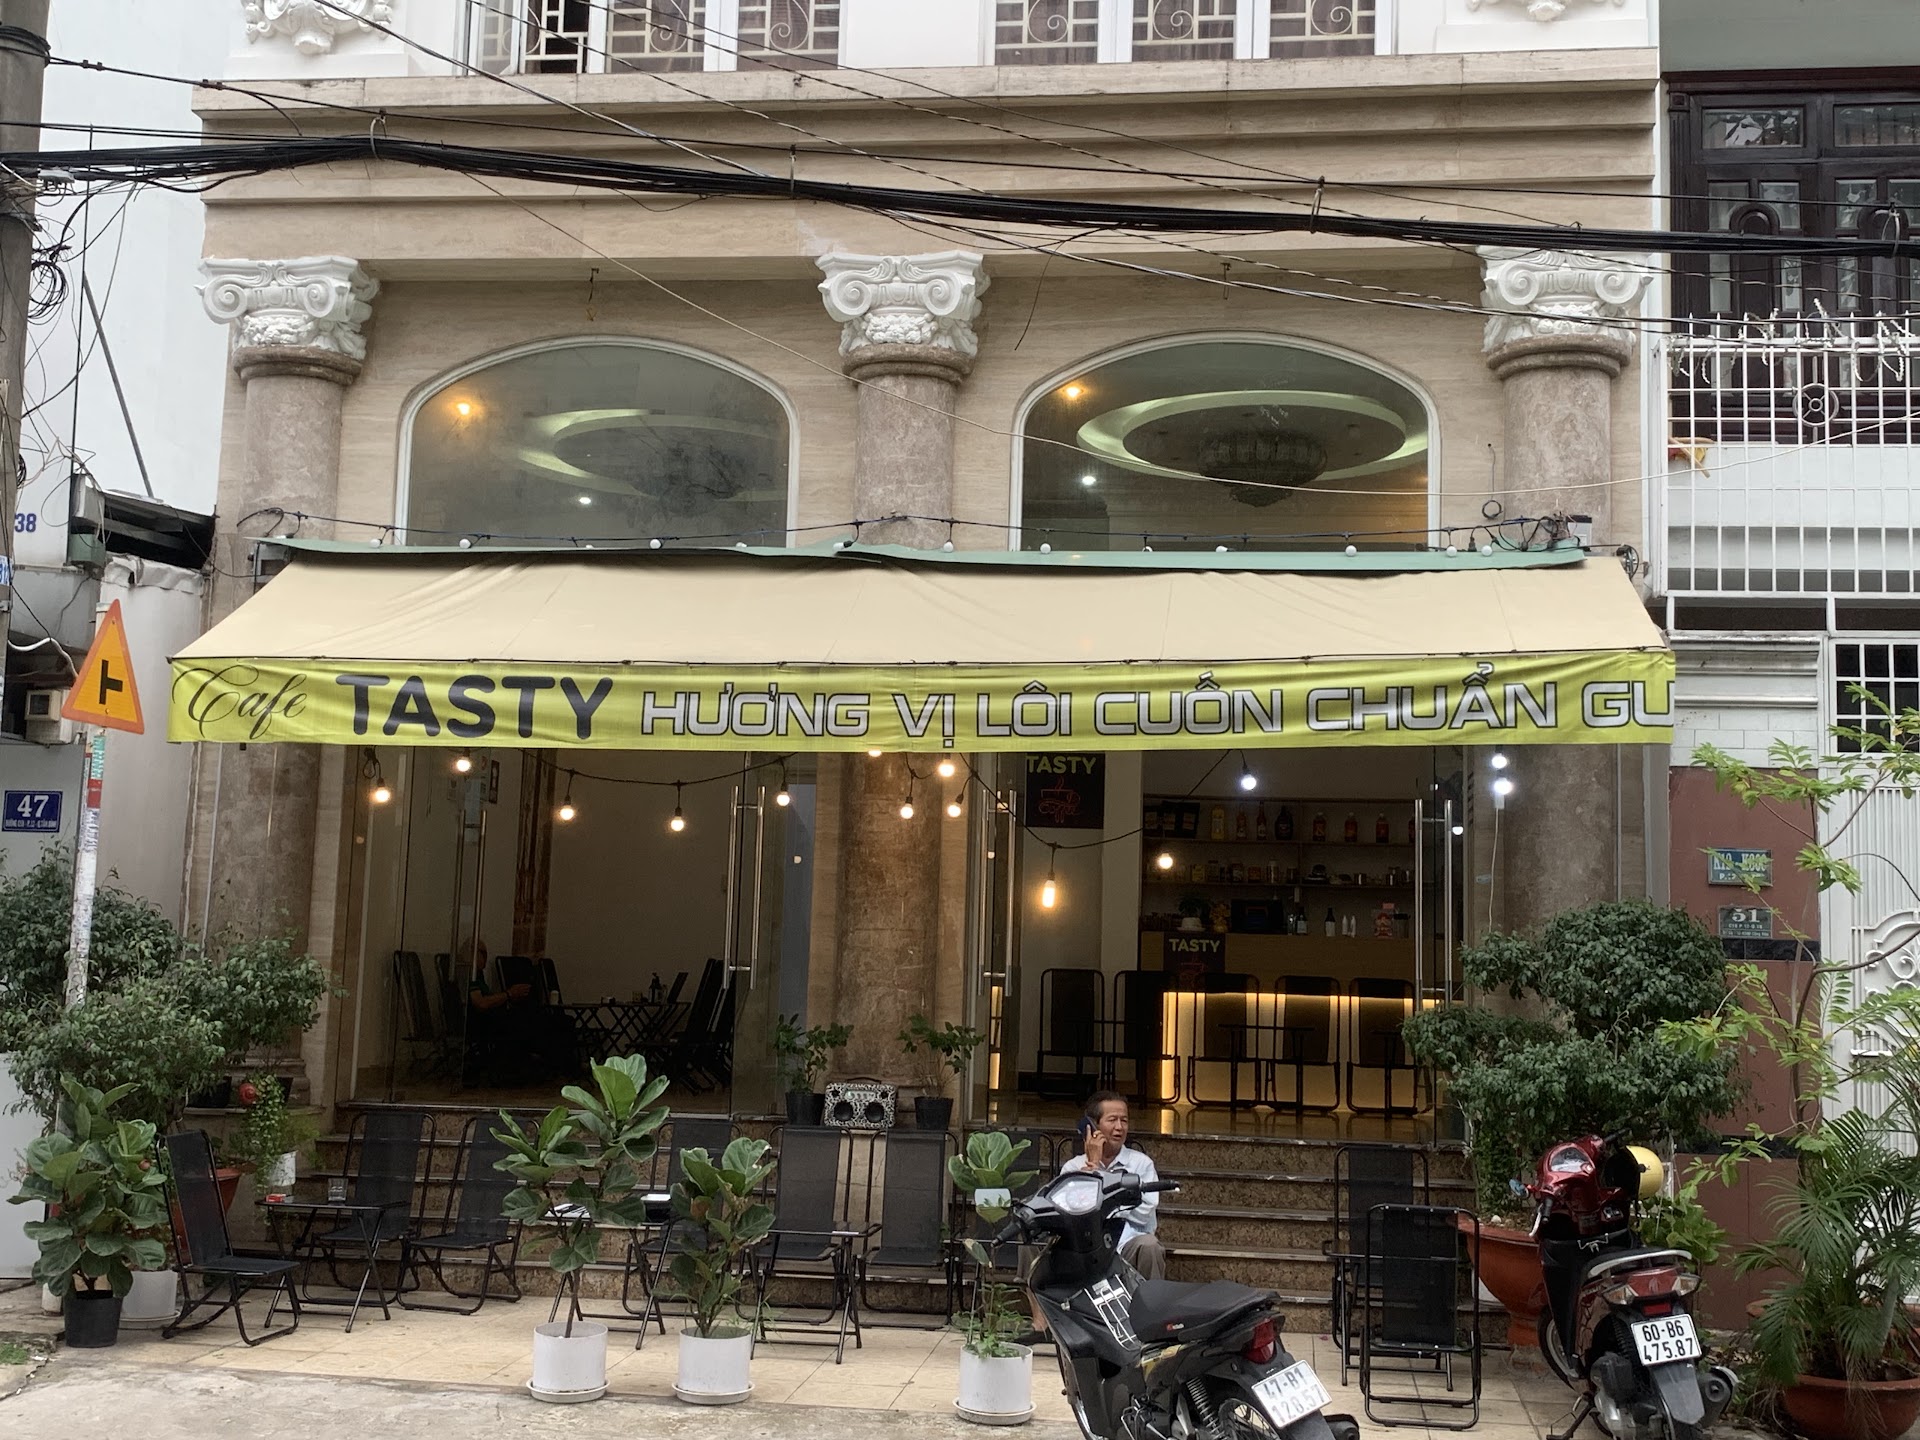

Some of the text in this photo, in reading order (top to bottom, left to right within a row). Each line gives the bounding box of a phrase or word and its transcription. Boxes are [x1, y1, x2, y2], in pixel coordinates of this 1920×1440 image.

[172, 665, 307, 740] Cafe
[335, 674, 614, 740] TASTY
[641, 682, 870, 737] HƯƠNG
[892, 692, 955, 748] VỊ
[976, 680, 1073, 737] LÔI
[1094, 670, 1283, 736] CUỐN
[1306, 661, 1558, 731] CHUẨN
[1025, 755, 1097, 774] TASTY
[17, 794, 49, 818] 47
[1732, 908, 1760, 923] 51
[1168, 938, 1220, 953] TASTY
[1642, 1320, 1684, 1342] 60-B6
[1644, 1338, 1692, 1362] 475.87
